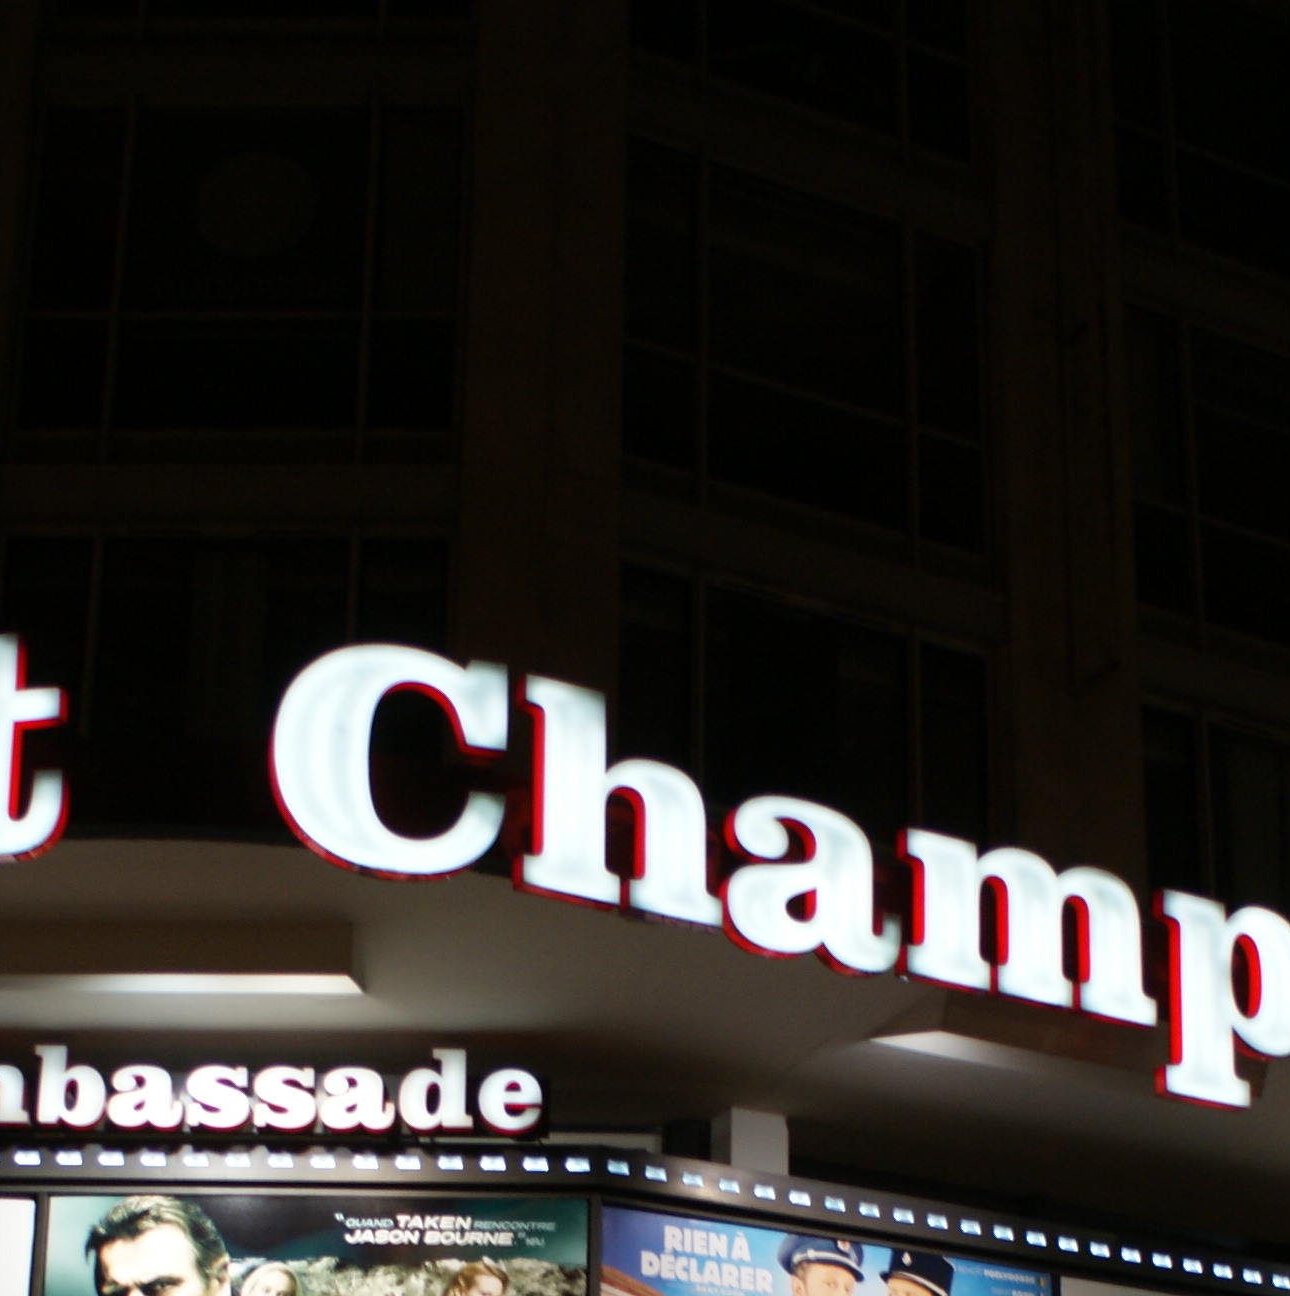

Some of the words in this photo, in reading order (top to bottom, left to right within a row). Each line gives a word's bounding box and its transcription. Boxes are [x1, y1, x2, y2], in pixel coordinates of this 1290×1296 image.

[396, 1214, 472, 1230] TAKEN
[473, 1221, 556, 1231] RENCONTRE
[345, 1229, 420, 1245] JASON
[664, 1225, 728, 1258] RIEN
[640, 1247, 773, 1294] DÉCLARER
